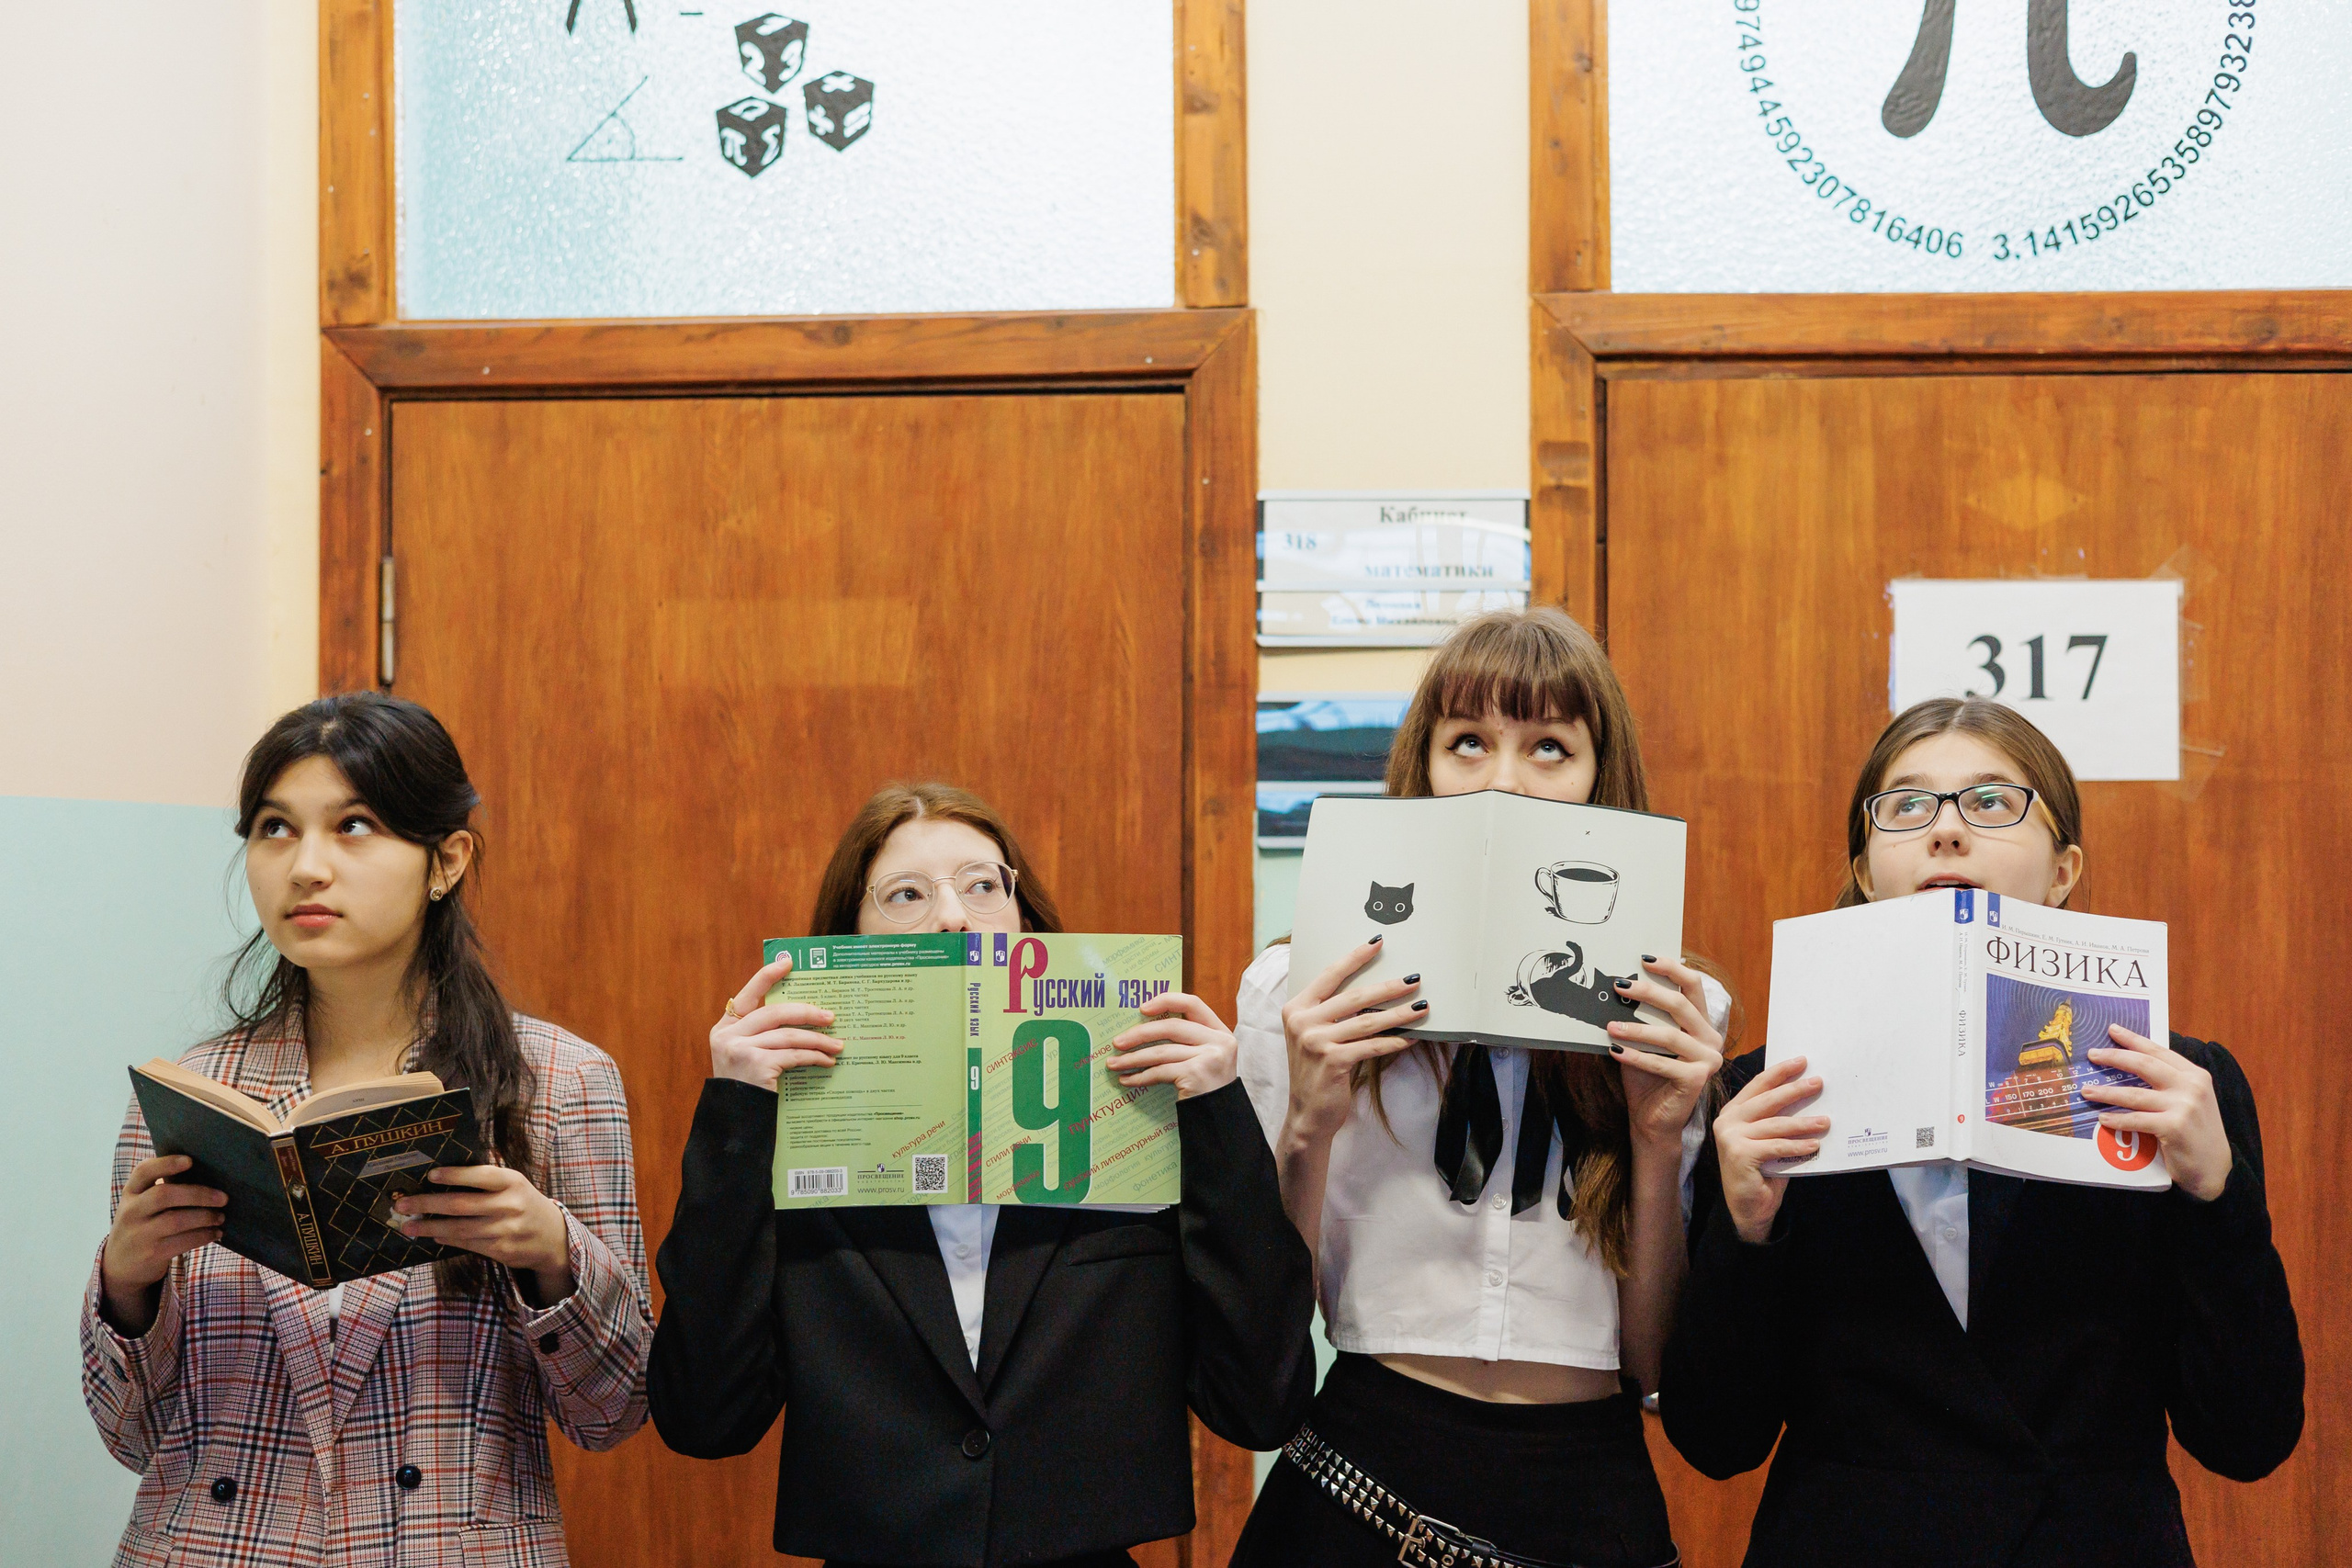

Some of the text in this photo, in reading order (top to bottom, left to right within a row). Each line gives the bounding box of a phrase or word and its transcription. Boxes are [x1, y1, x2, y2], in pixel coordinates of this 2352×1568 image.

[1283, 533, 1317, 550] 318
[1364, 565, 1494, 579] математики
[1965, 633, 2109, 702] 317
[1003, 937, 1105, 1017] Русский
[1986, 936, 2149, 989] ФИЗИКА
[967, 983, 981, 1036] Русский язык
[1958, 1010, 1967, 1056] ФИЗИКА
[986, 1039, 1038, 1074] синтаксис
[1074, 1043, 1112, 1069] сложное
[970, 1066, 979, 1090] 9
[2038, 1088, 2054, 1096] 200
[2061, 1083, 2077, 1091] 250
[2105, 1074, 2122, 1082] 350
[1012, 1020, 1091, 1204] 9
[1068, 1086, 1148, 1135] пунктуация
[332, 1121, 442, 1154] А. ПУШКИН
[891, 1132, 927, 1159] культура
[926, 1120, 946, 1138] речи
[985, 1148, 1011, 1168] стили
[1010, 1135, 1032, 1153] речи
[1101, 1128, 1163, 1169] литературный
[1848, 1135, 1888, 1145] ПРОСВЕЩЕНИЕ
[1848, 1147, 1888, 1157] www.prosv.ru
[2115, 1130, 2139, 1161] 9
[1133, 1161, 1178, 1192] фонетика
[297, 1213, 323, 1266] А. ПУШКИН
